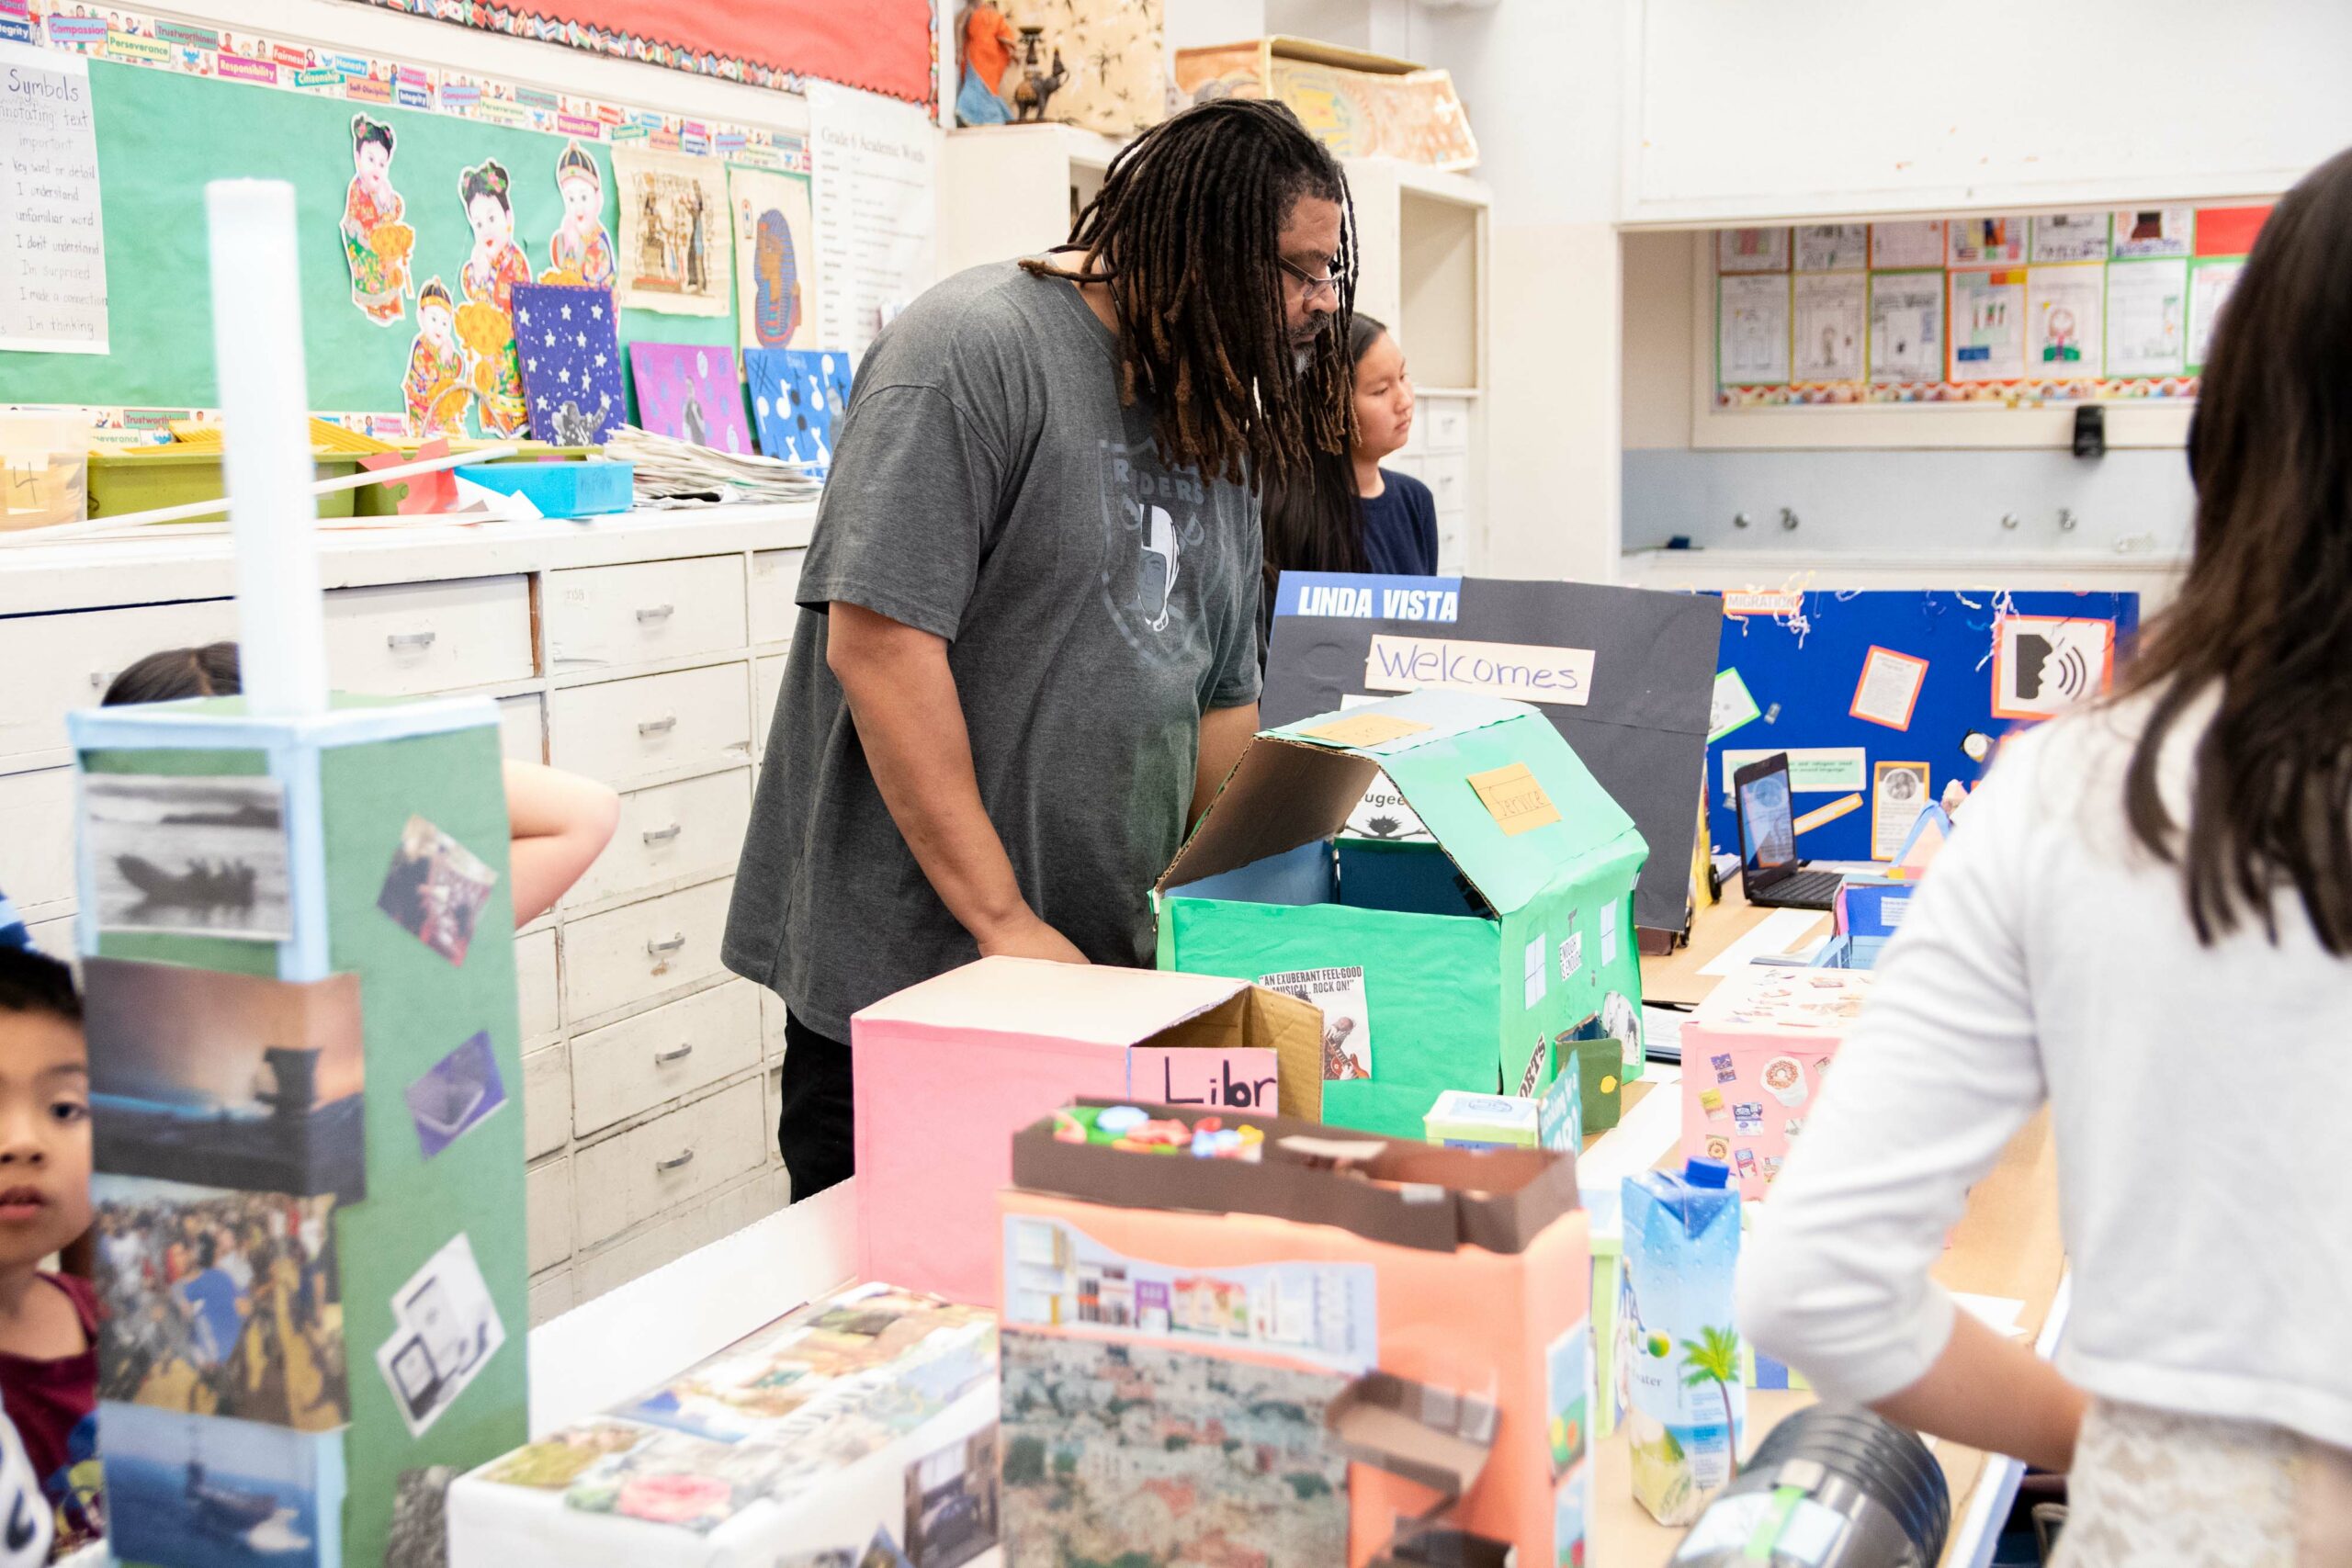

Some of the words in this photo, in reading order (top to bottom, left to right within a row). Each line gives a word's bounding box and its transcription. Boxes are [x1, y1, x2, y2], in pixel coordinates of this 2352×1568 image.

[51, 23, 107, 36] Compassion
[157, 26, 217, 45] Trustworthiness
[109, 37, 169, 55] Perseverance
[274, 49, 304, 65] Fairness
[220, 60, 275, 79] Responsibility
[8, 68, 79, 102] Symbols
[63, 109, 88, 126] text
[69, 164, 96, 179] detail
[16, 207, 63, 224] unfamiliar
[71, 211, 94, 226] word
[52, 240, 99, 255] understand
[51, 315, 94, 340] thinking
[126, 414, 169, 425] Trustworth
[14, 461, 39, 506] 4
[1297, 586, 1373, 617] LINDA
[1383, 589, 1458, 622] VISTA
[1376, 642, 1578, 690] Welcomes
[1364, 794, 1404, 807] ugee
[1277, 970, 1321, 986] EXUBERANT
[1313, 981, 1333, 994] ROCK
[1165, 1055, 1276, 1108] Libr
